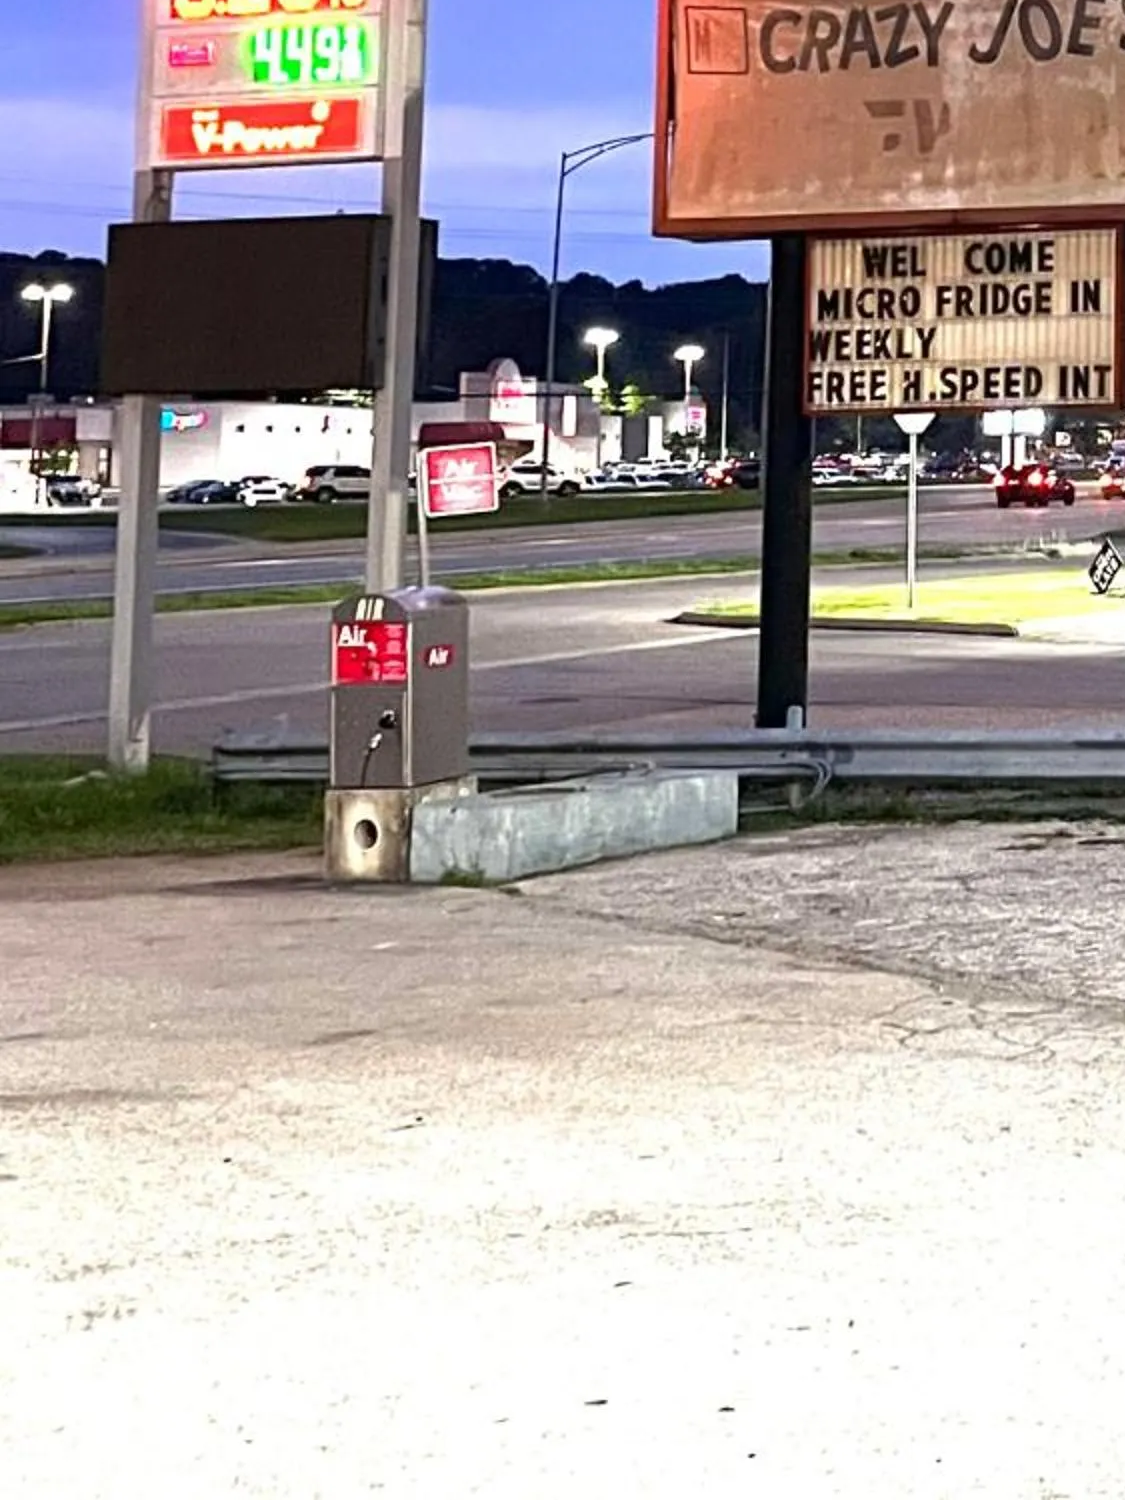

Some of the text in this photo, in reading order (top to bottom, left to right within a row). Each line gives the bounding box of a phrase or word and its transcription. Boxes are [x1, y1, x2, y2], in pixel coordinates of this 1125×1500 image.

[759, 1, 955, 75] CRAZY
[862, 239, 1055, 278] WEL COME
[817, 279, 1101, 321] MICRO FRIDGE IN
[810, 326, 938, 361] WEEKLY
[808, 369, 887, 403] FREE
[1058, 364, 1112, 399] INT
[338, 624, 367, 647] Air
